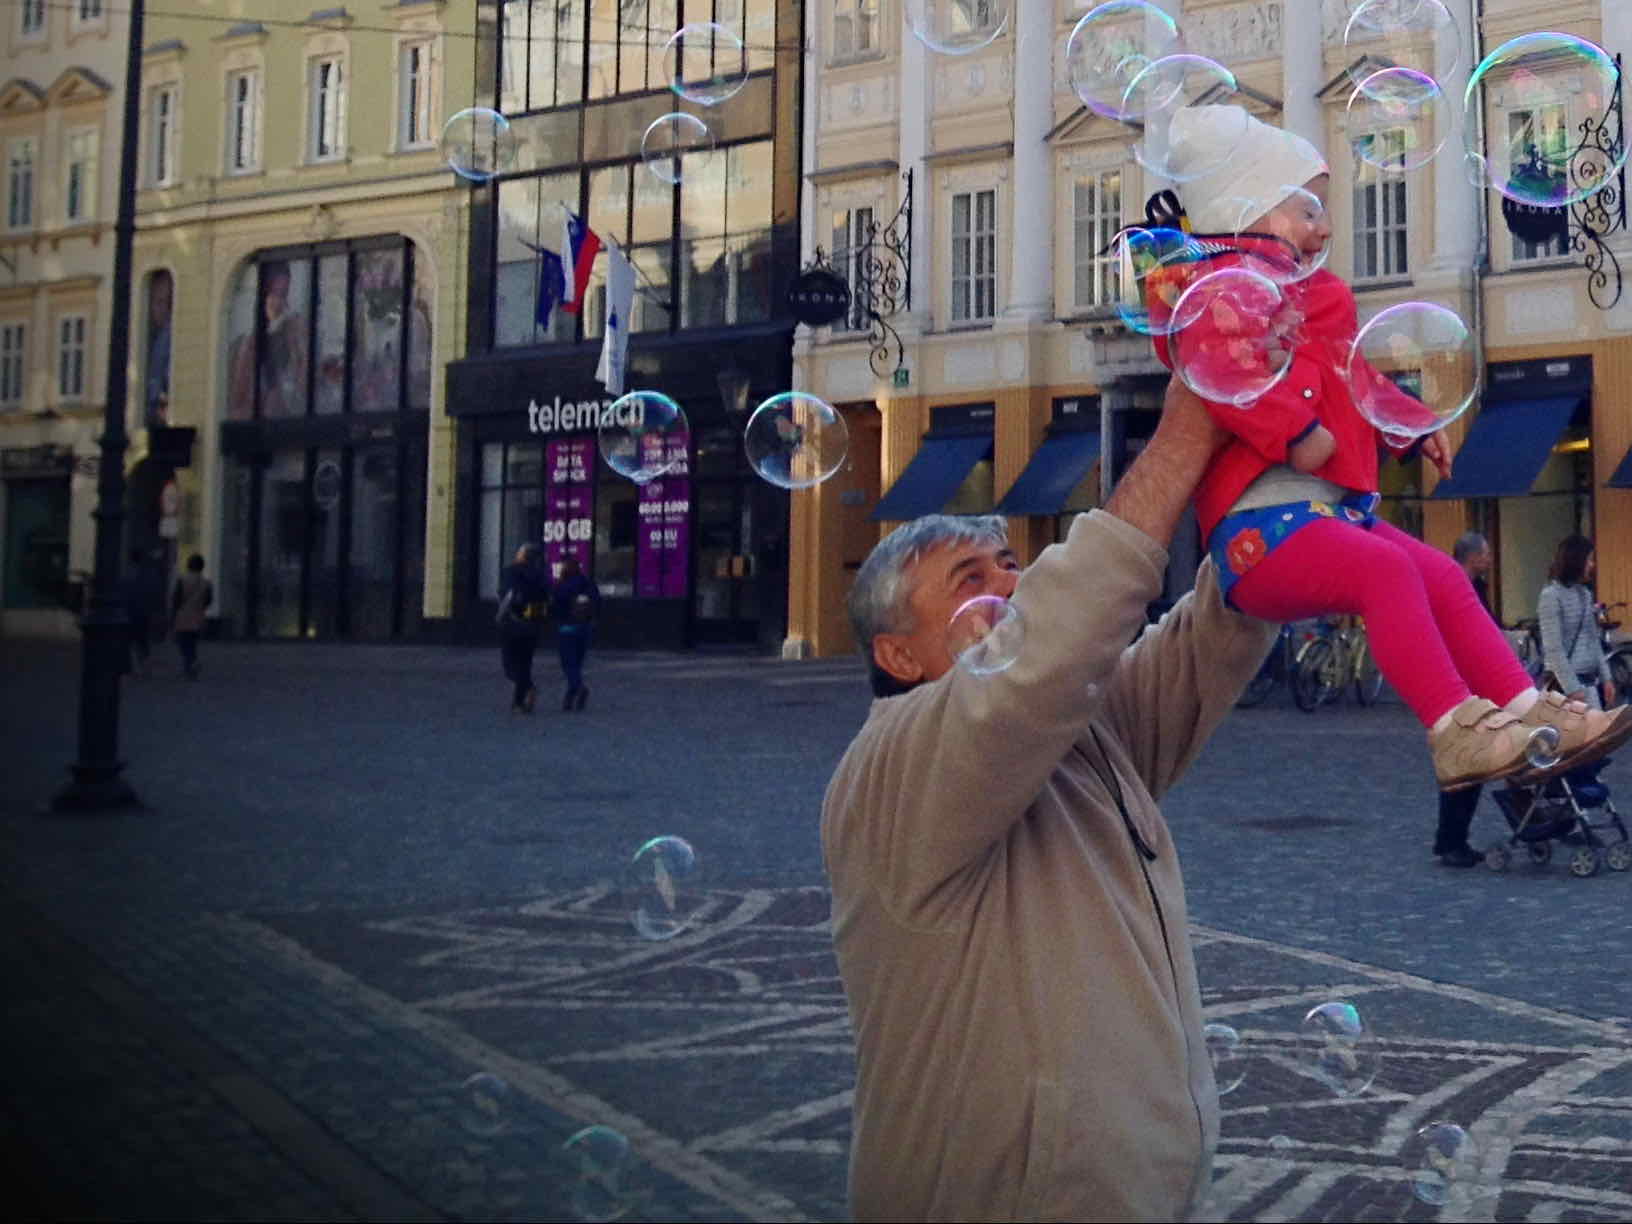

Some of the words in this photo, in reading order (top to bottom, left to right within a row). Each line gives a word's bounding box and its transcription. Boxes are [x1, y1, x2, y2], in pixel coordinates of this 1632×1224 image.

[789, 292, 846, 304] IKONA
[544, 520, 565, 543] 50
[567, 518, 592, 541] GB
